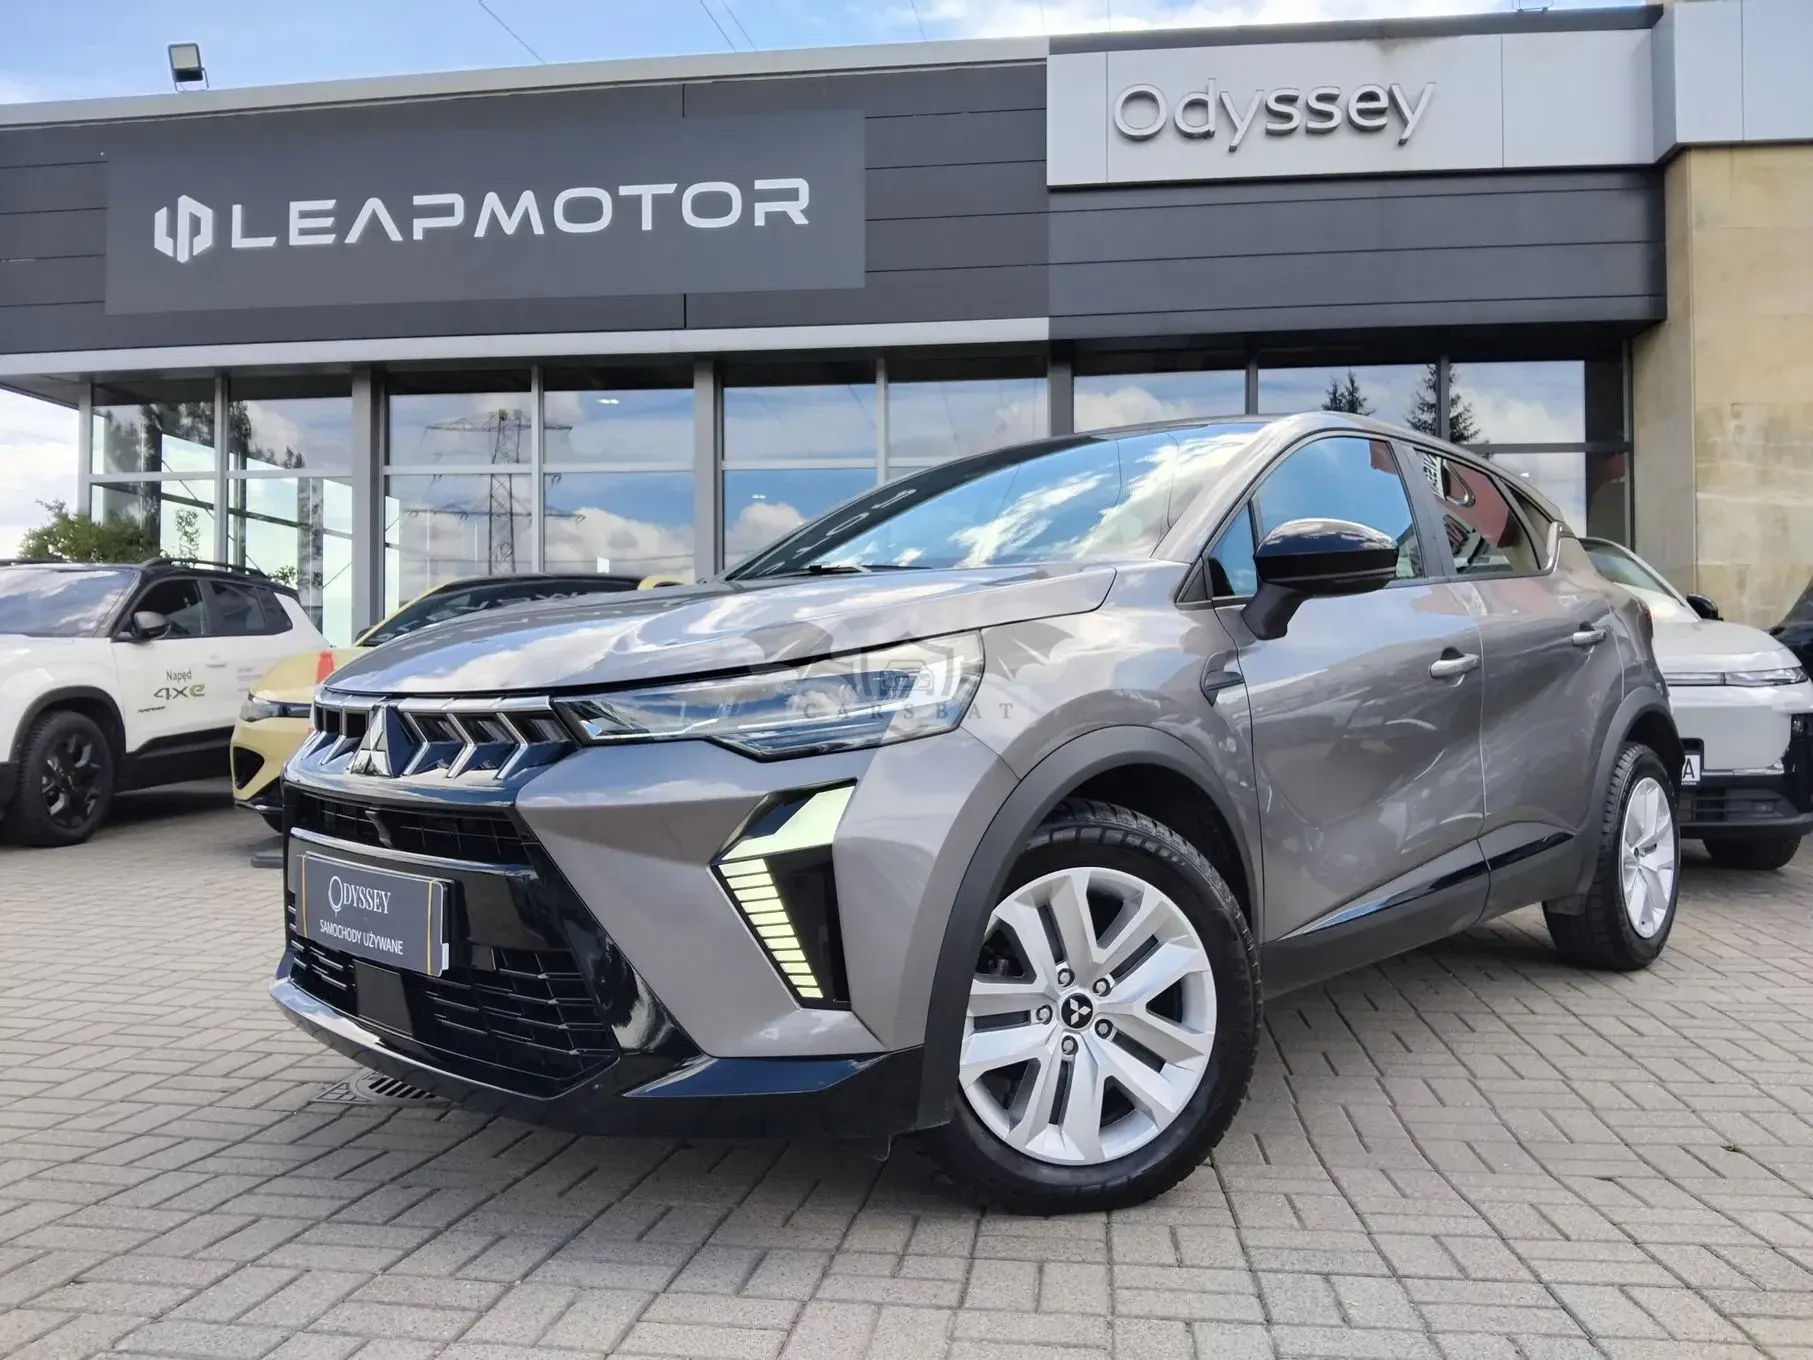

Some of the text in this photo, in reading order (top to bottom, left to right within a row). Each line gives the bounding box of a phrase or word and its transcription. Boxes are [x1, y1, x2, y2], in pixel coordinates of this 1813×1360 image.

[1113, 77, 1436, 153] Odyssey
[231, 177, 810, 249] LEAPMOTOR
[328, 875, 391, 917] ODYSSEY
[319, 919, 404, 956] SAMOCHODY UŻYWANE
